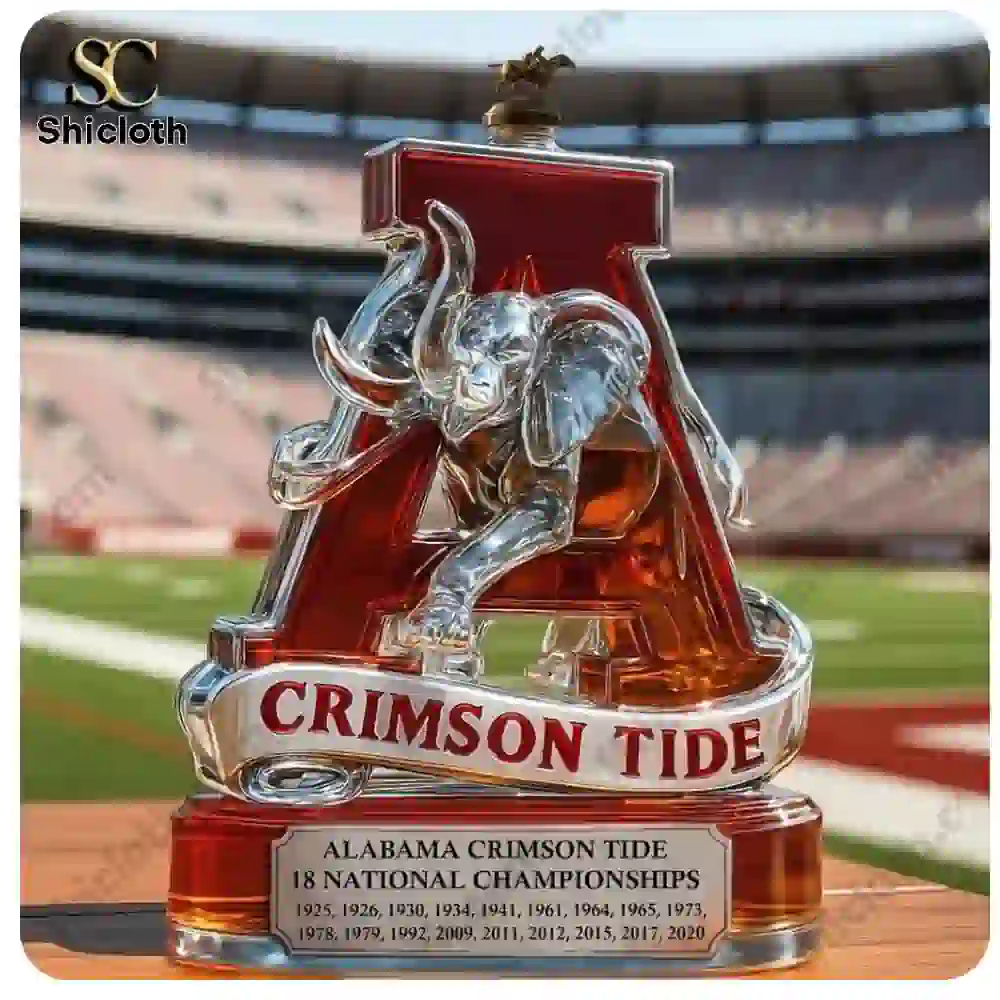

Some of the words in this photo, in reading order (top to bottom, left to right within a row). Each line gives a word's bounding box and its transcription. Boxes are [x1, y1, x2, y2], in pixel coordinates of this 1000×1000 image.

[259, 680, 588, 774] CRIMSON
[612, 718, 766, 780] TIDE
[322, 839, 460, 860] ALABAMA
[467, 839, 596, 860] CRIMSON
[603, 839, 669, 860] TIDE
[293, 869, 316, 890] 18
[323, 869, 465, 890] NATIONAL
[473, 869, 701, 890] CHAMPIONSHIPS
[296, 902, 337, 920] 1925,
[342, 902, 383, 920] 1926,
[388, 902, 429, 920] 1930,
[434, 902, 476, 920] 1934,
[480, 902, 522, 920] 1941,
[527, 902, 568, 920] 1961,
[574, 902, 615, 920] 1964,
[620, 902, 661, 920] 1965,
[666, 902, 707, 920] 1973,
[298, 925, 339, 943] 1978,
[344, 925, 385, 943] 1979,
[391, 925, 431, 943] 1992,
[435, 925, 477, 943] 2009,
[481, 925, 524, 943] 2011,
[527, 925, 570, 943] 2012,
[575, 925, 616, 943] 2015,
[621, 925, 663, 943] 2017,
[667, 925, 706, 943] 2020
